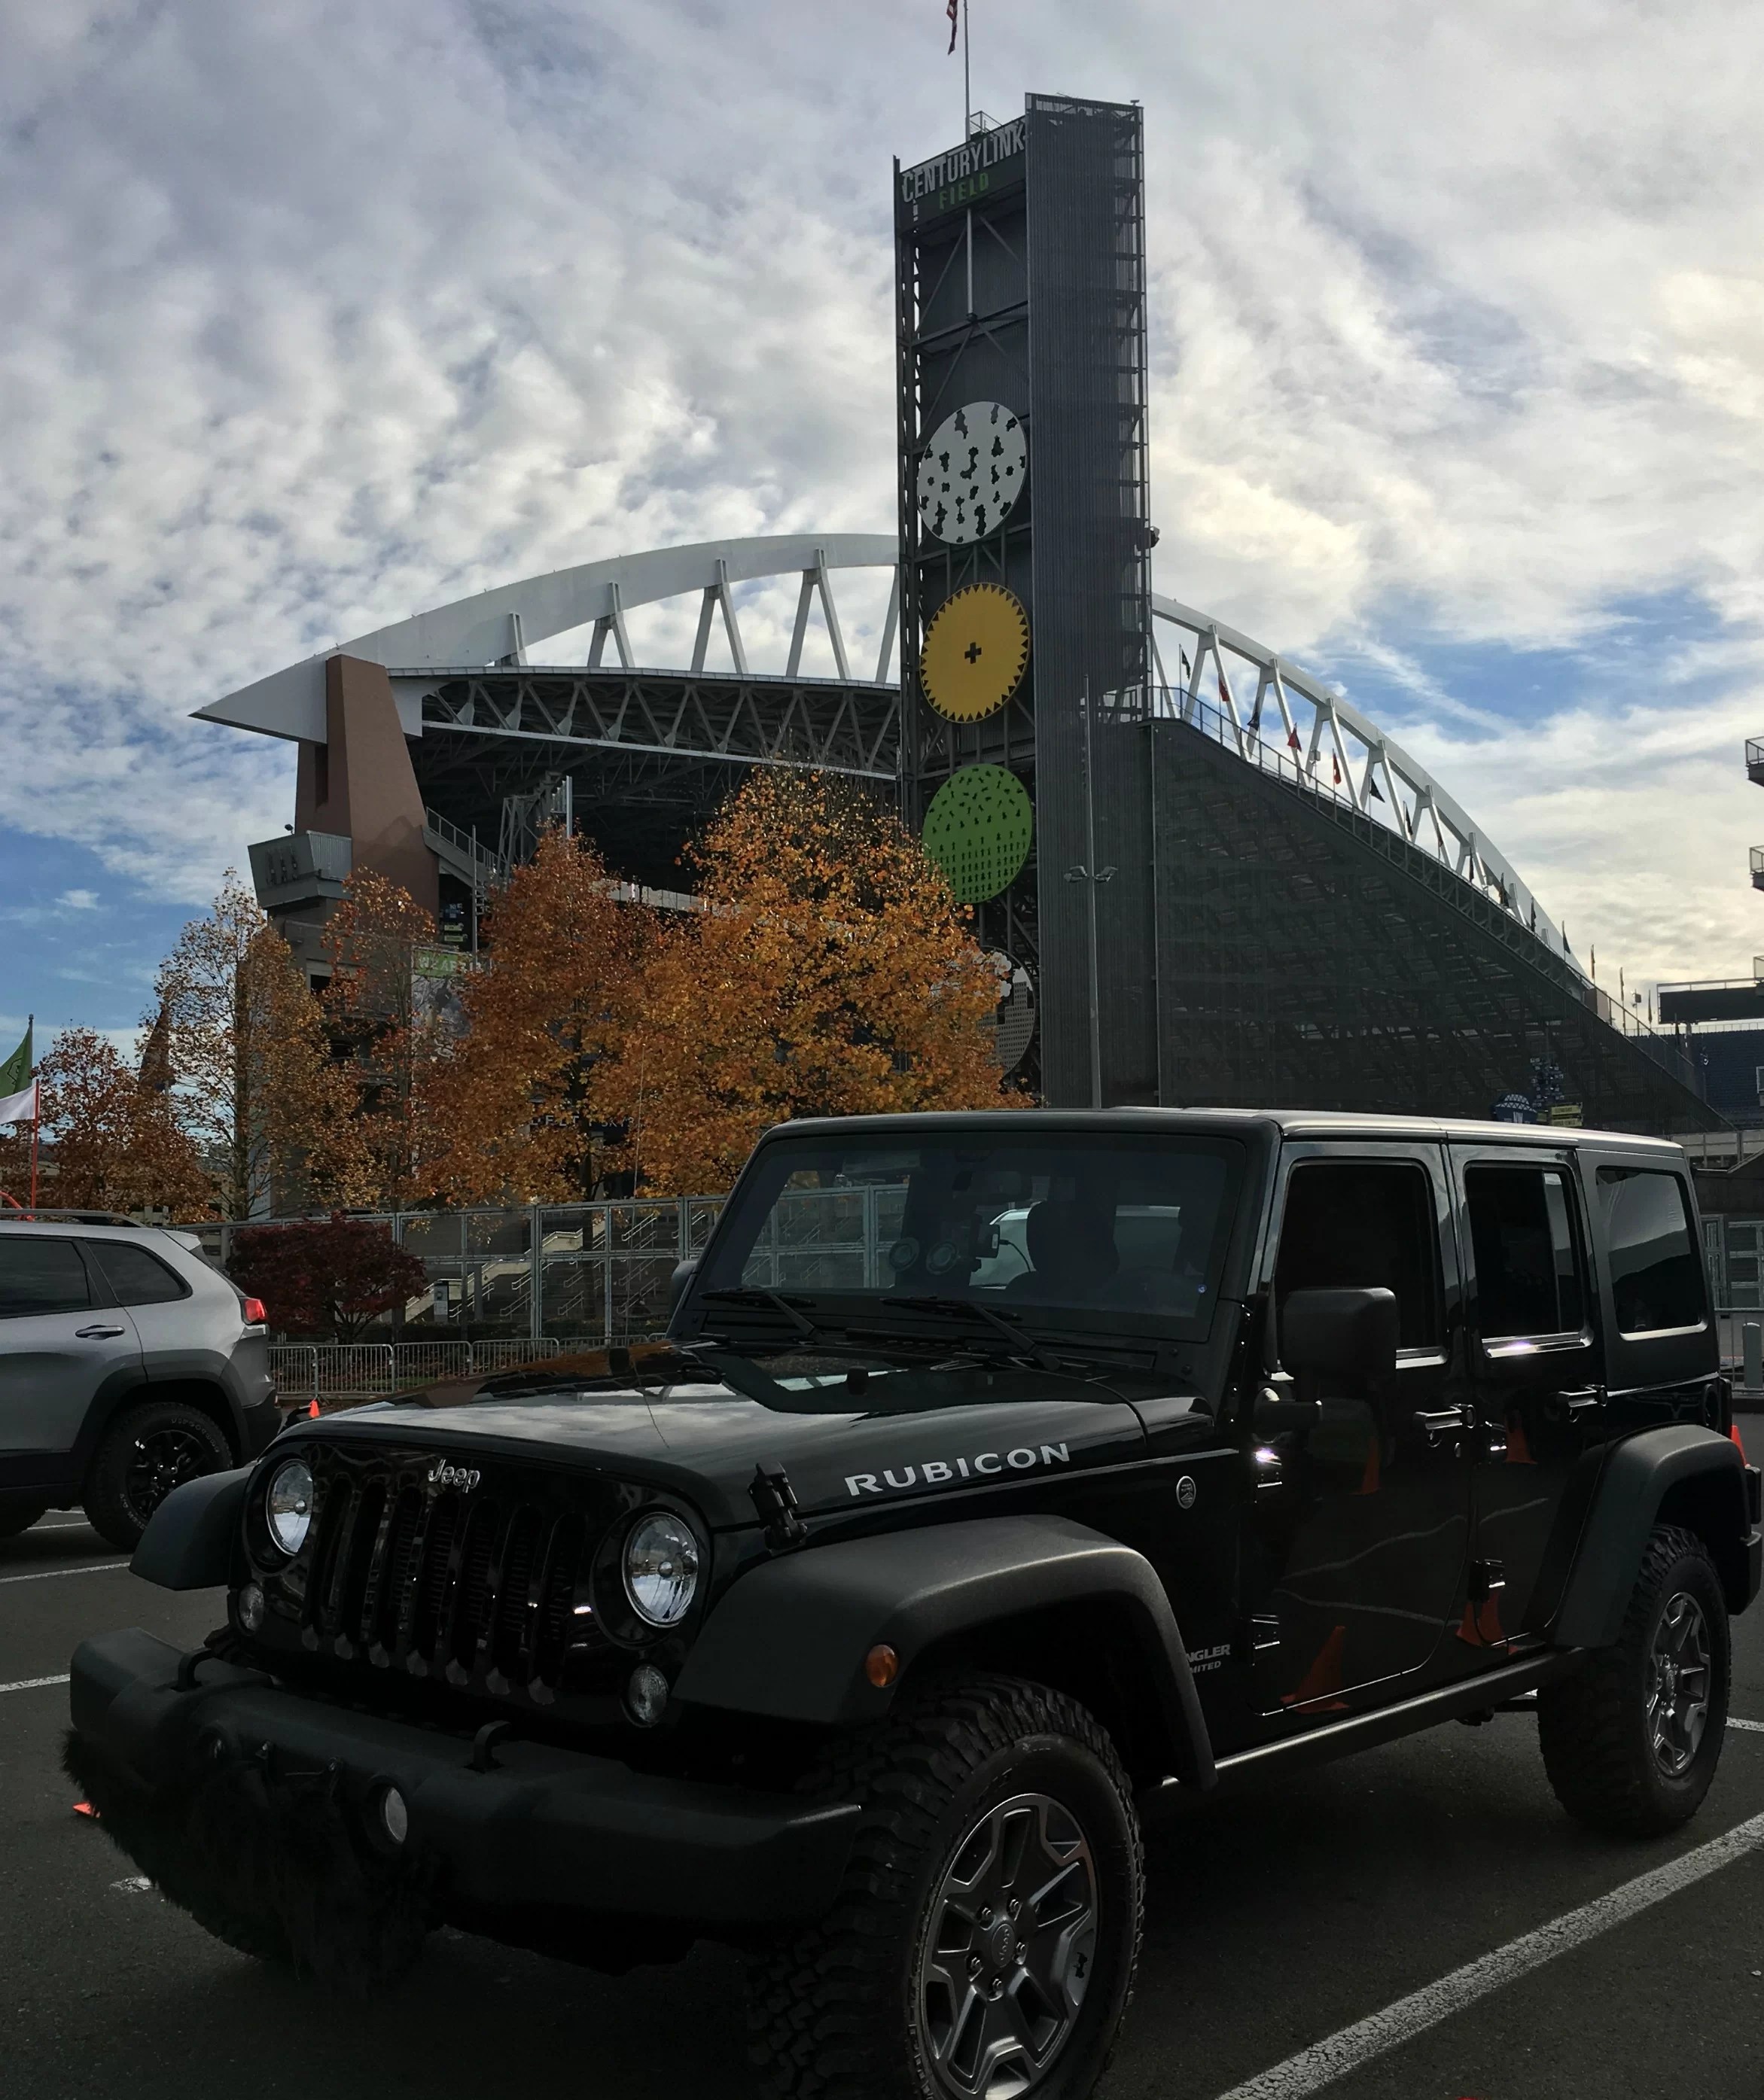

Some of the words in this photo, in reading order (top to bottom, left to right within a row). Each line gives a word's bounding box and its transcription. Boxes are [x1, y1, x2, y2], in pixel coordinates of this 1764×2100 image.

[902, 123, 1025, 202] CENTURYLINK
[940, 172, 989, 210] FIELD
[428, 1459, 480, 1493] Jeep
[844, 1443, 1070, 1496] RUBICON
[1186, 1644, 1231, 1663] NGLER
